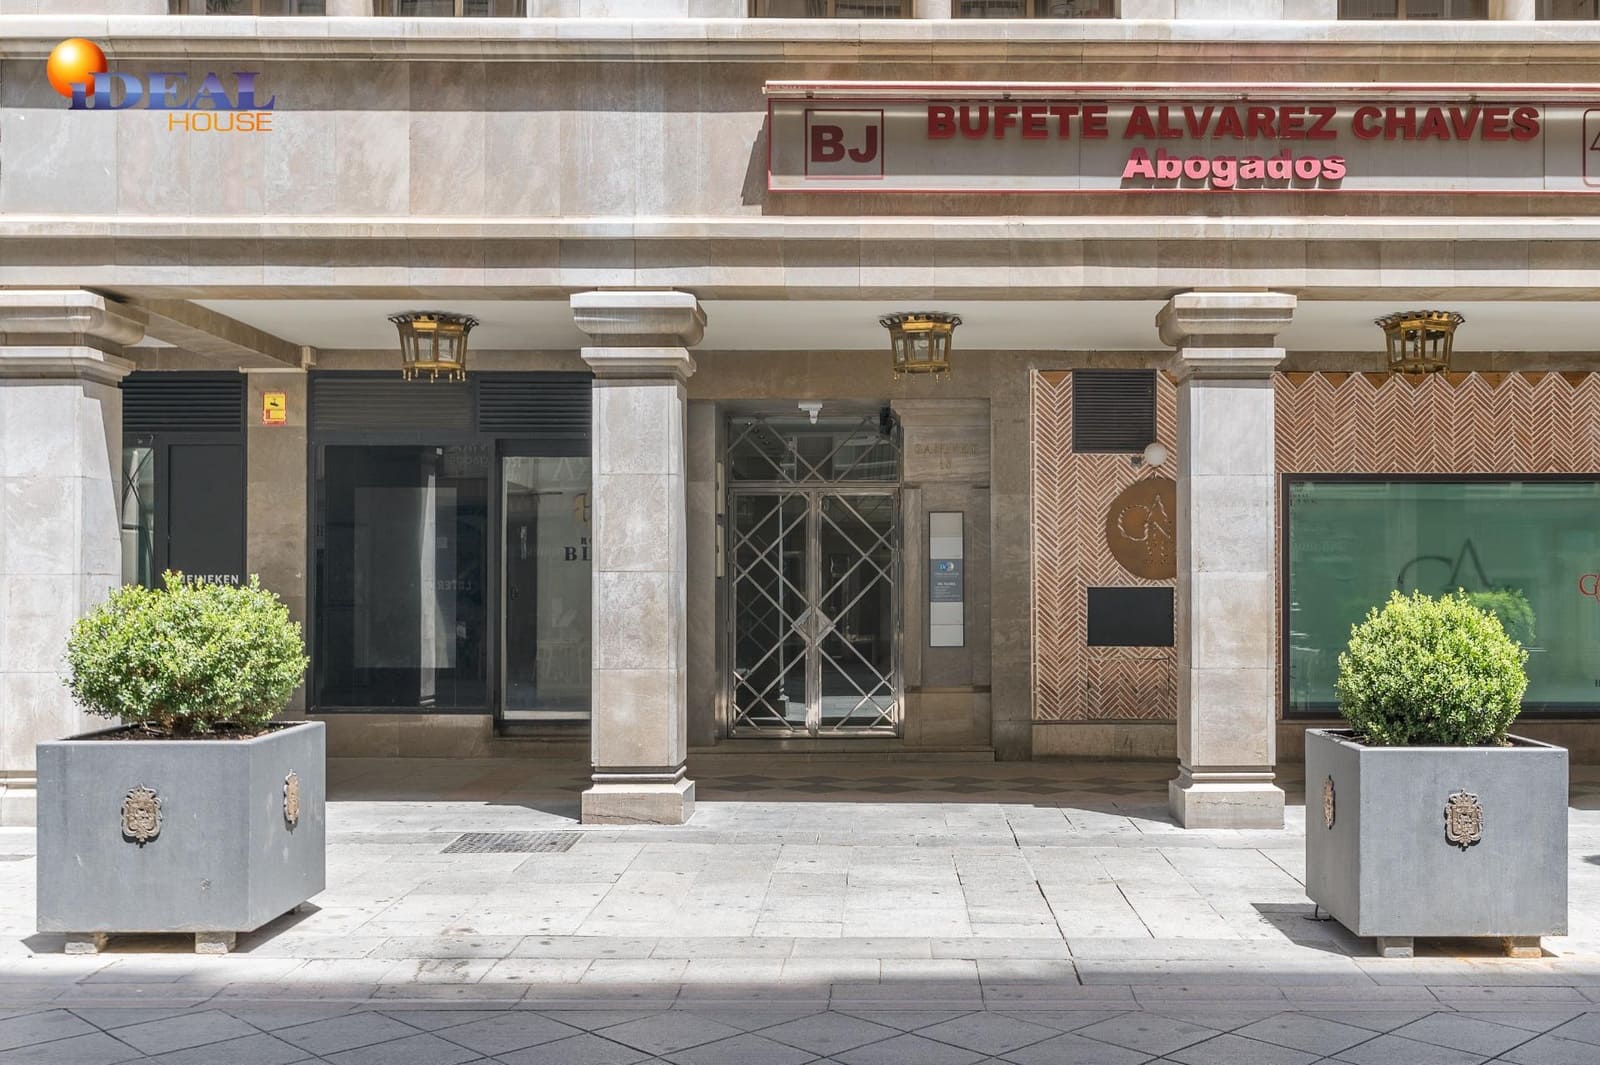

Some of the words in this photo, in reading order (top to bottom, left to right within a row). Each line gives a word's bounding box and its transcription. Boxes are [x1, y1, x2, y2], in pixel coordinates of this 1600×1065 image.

[927, 105, 1109, 140] BUFETE
[1124, 105, 1338, 141] ALVAREZ
[1352, 106, 1541, 142] CHAVES
[811, 125, 878, 163] BJ
[1123, 147, 1347, 188] Abogados
